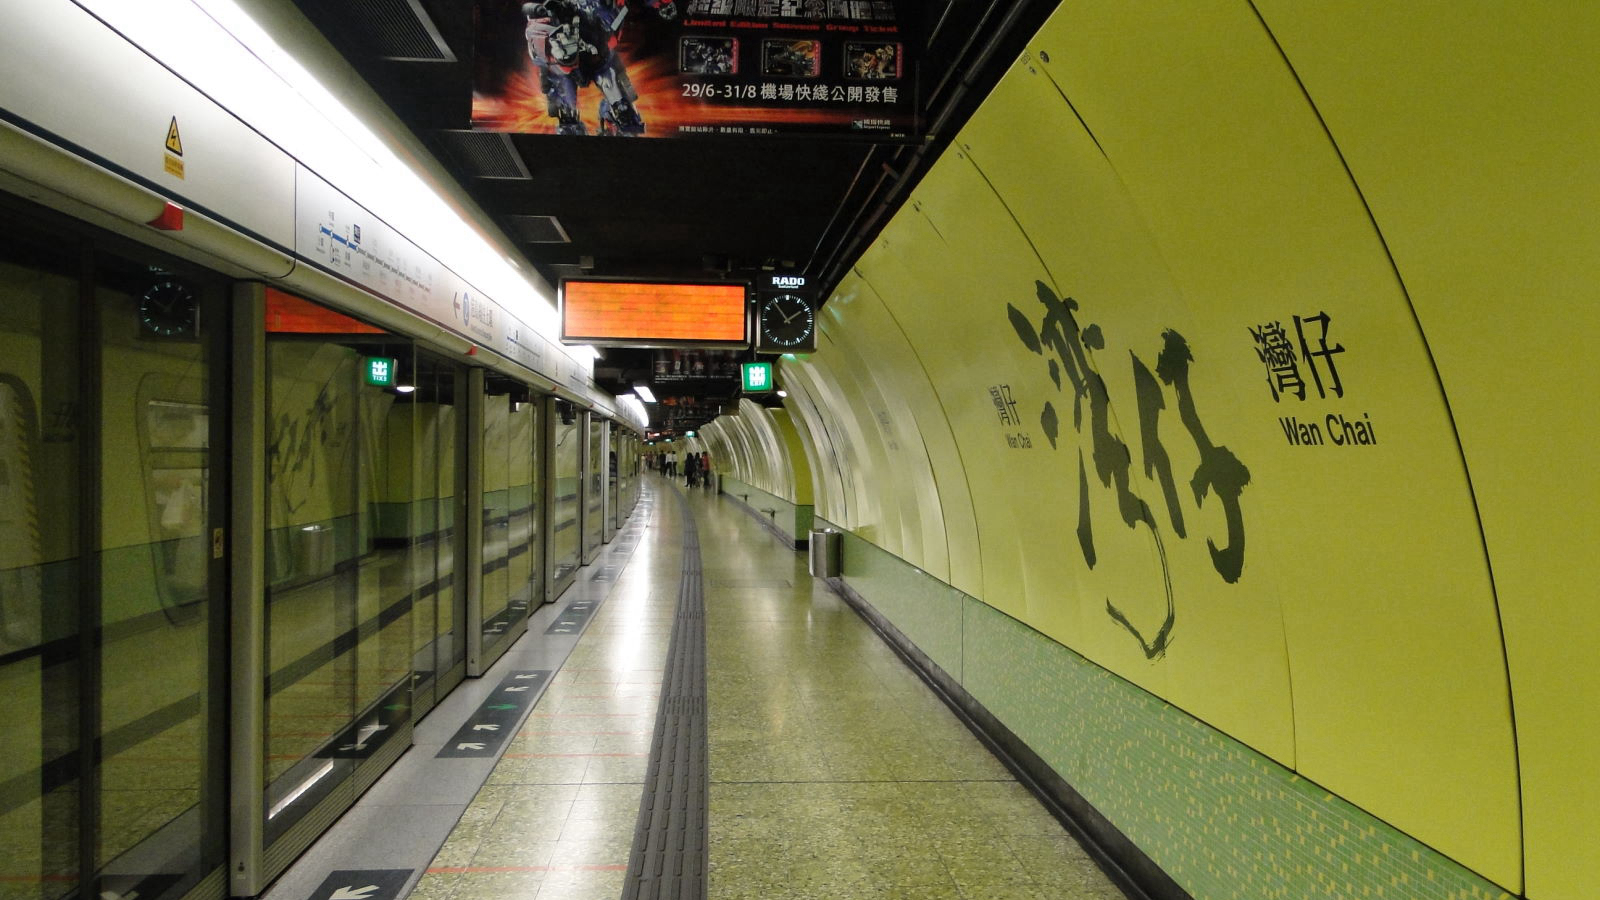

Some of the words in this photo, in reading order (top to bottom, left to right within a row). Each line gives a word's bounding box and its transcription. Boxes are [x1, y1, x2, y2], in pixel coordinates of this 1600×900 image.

[772, 276, 805, 286] RADO
[1247, 311, 1346, 403] 灣仔
[987, 384, 1021, 426] 灣仔
[1004, 431, 1018, 449] Wan
[1018, 431, 1033, 449] Chai
[1278, 416, 1324, 446] Wan
[1325, 412, 1377, 447] Chai
